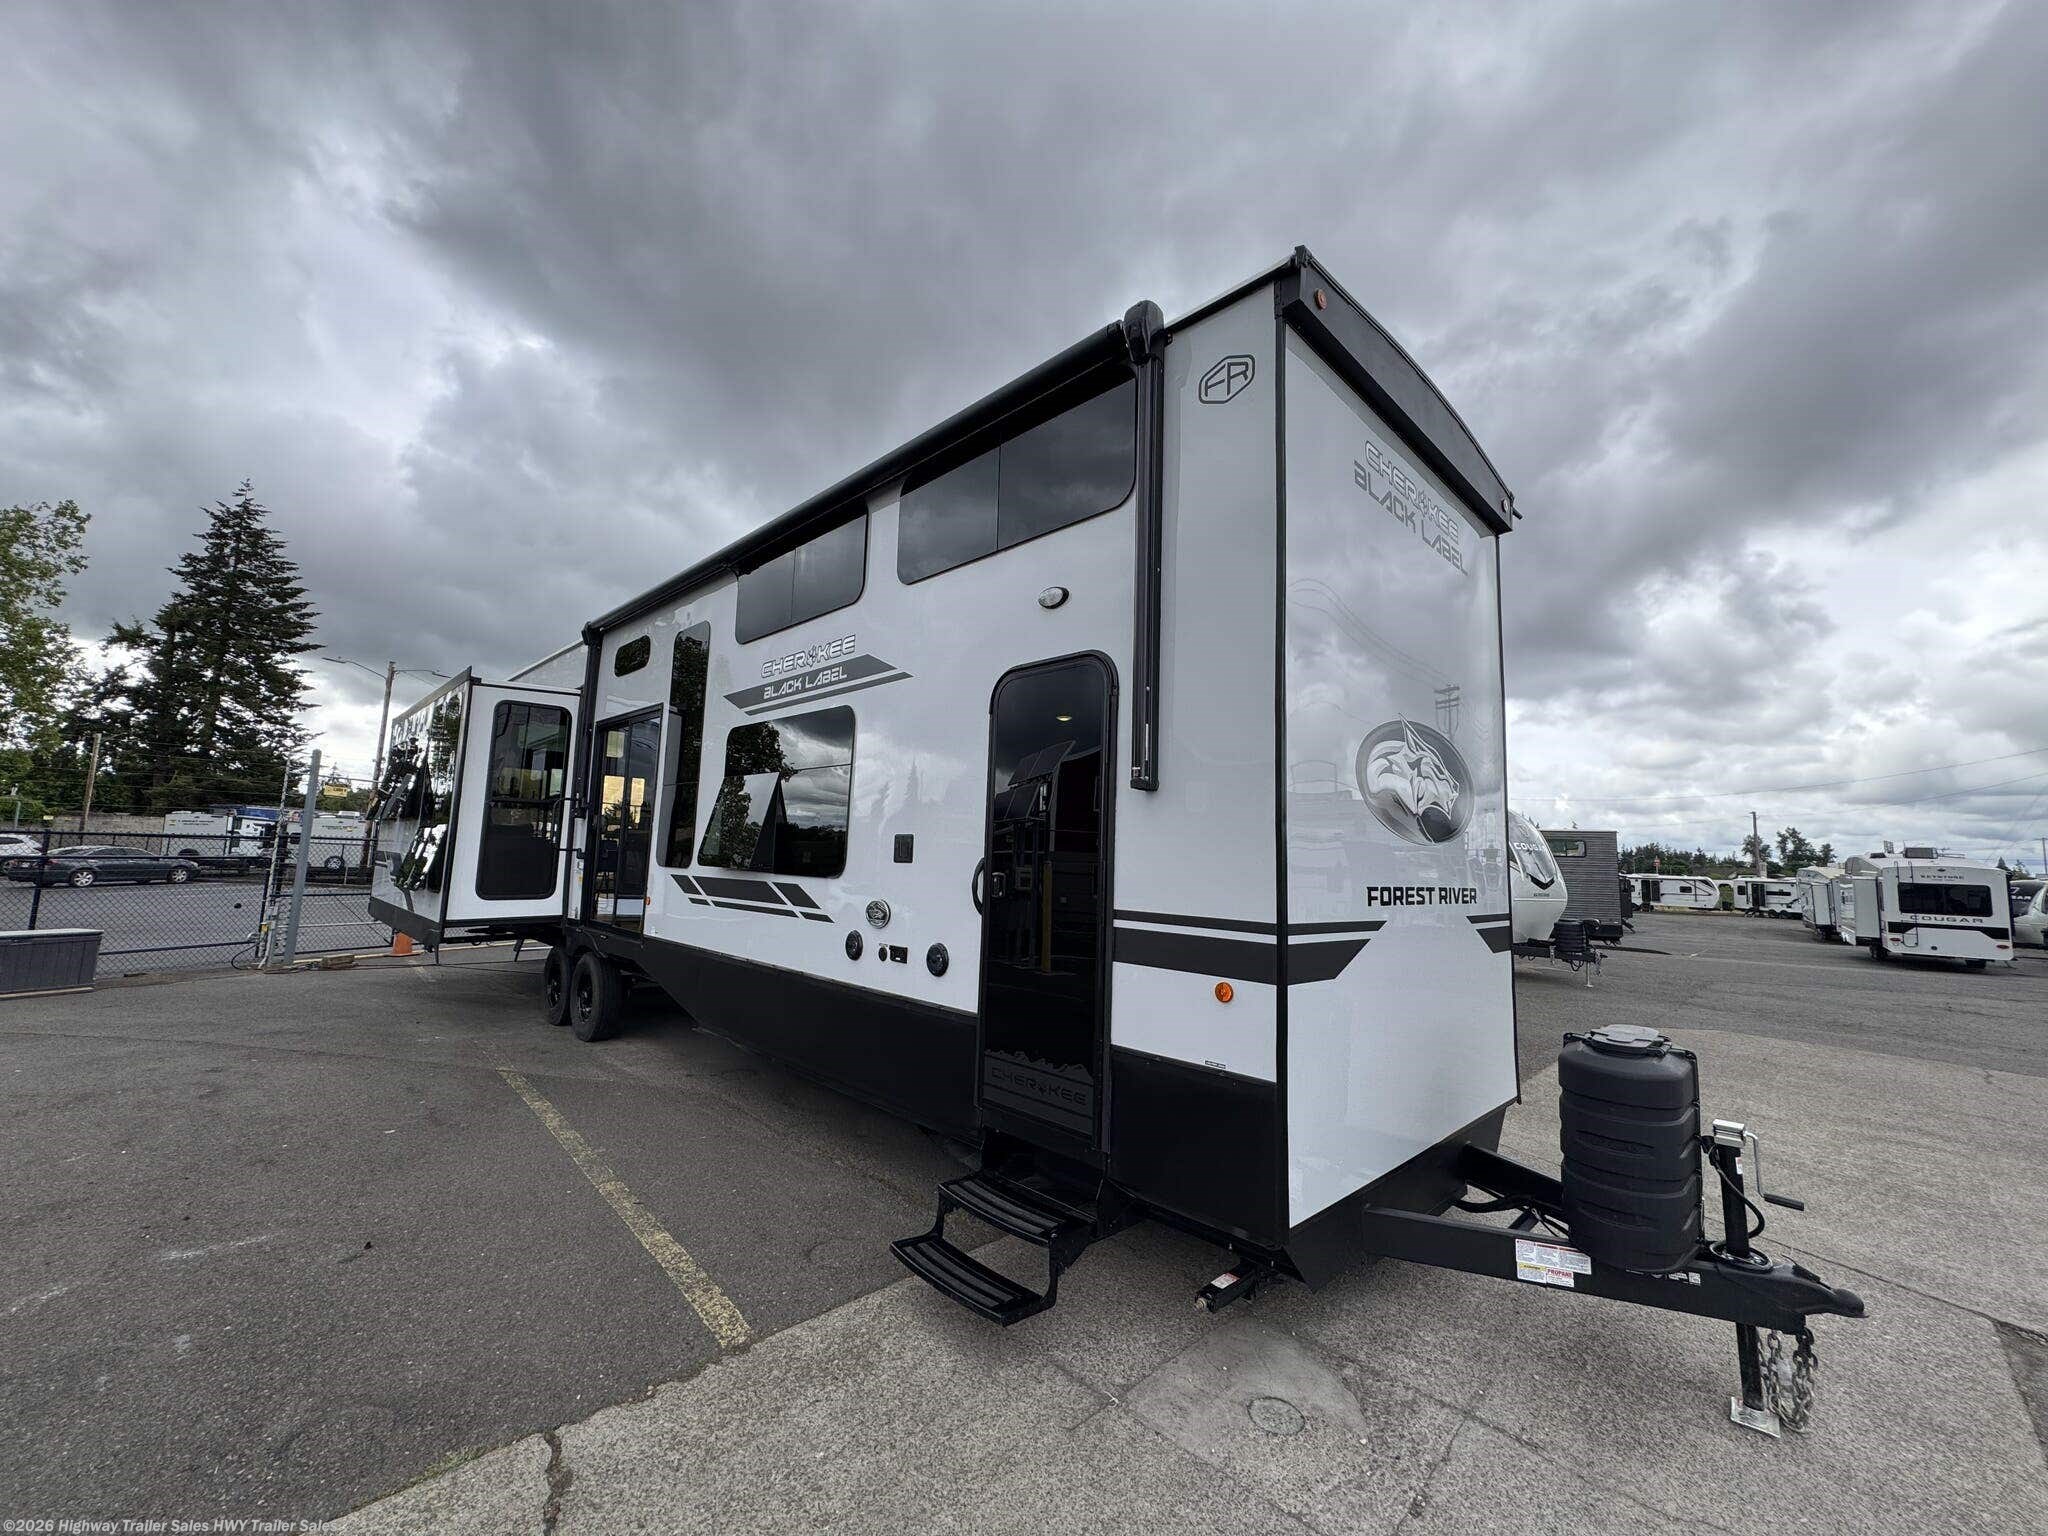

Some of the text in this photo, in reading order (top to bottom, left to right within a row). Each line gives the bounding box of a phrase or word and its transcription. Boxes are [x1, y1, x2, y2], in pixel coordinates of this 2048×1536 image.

[1354, 459, 1469, 577] BLACK LABEL
[760, 634, 857, 679] CHEROKEE
[763, 666, 848, 700] BLACK LABEL
[1366, 886, 1478, 906] FOREST RIVER
[1910, 913, 1984, 924] COUGAR
